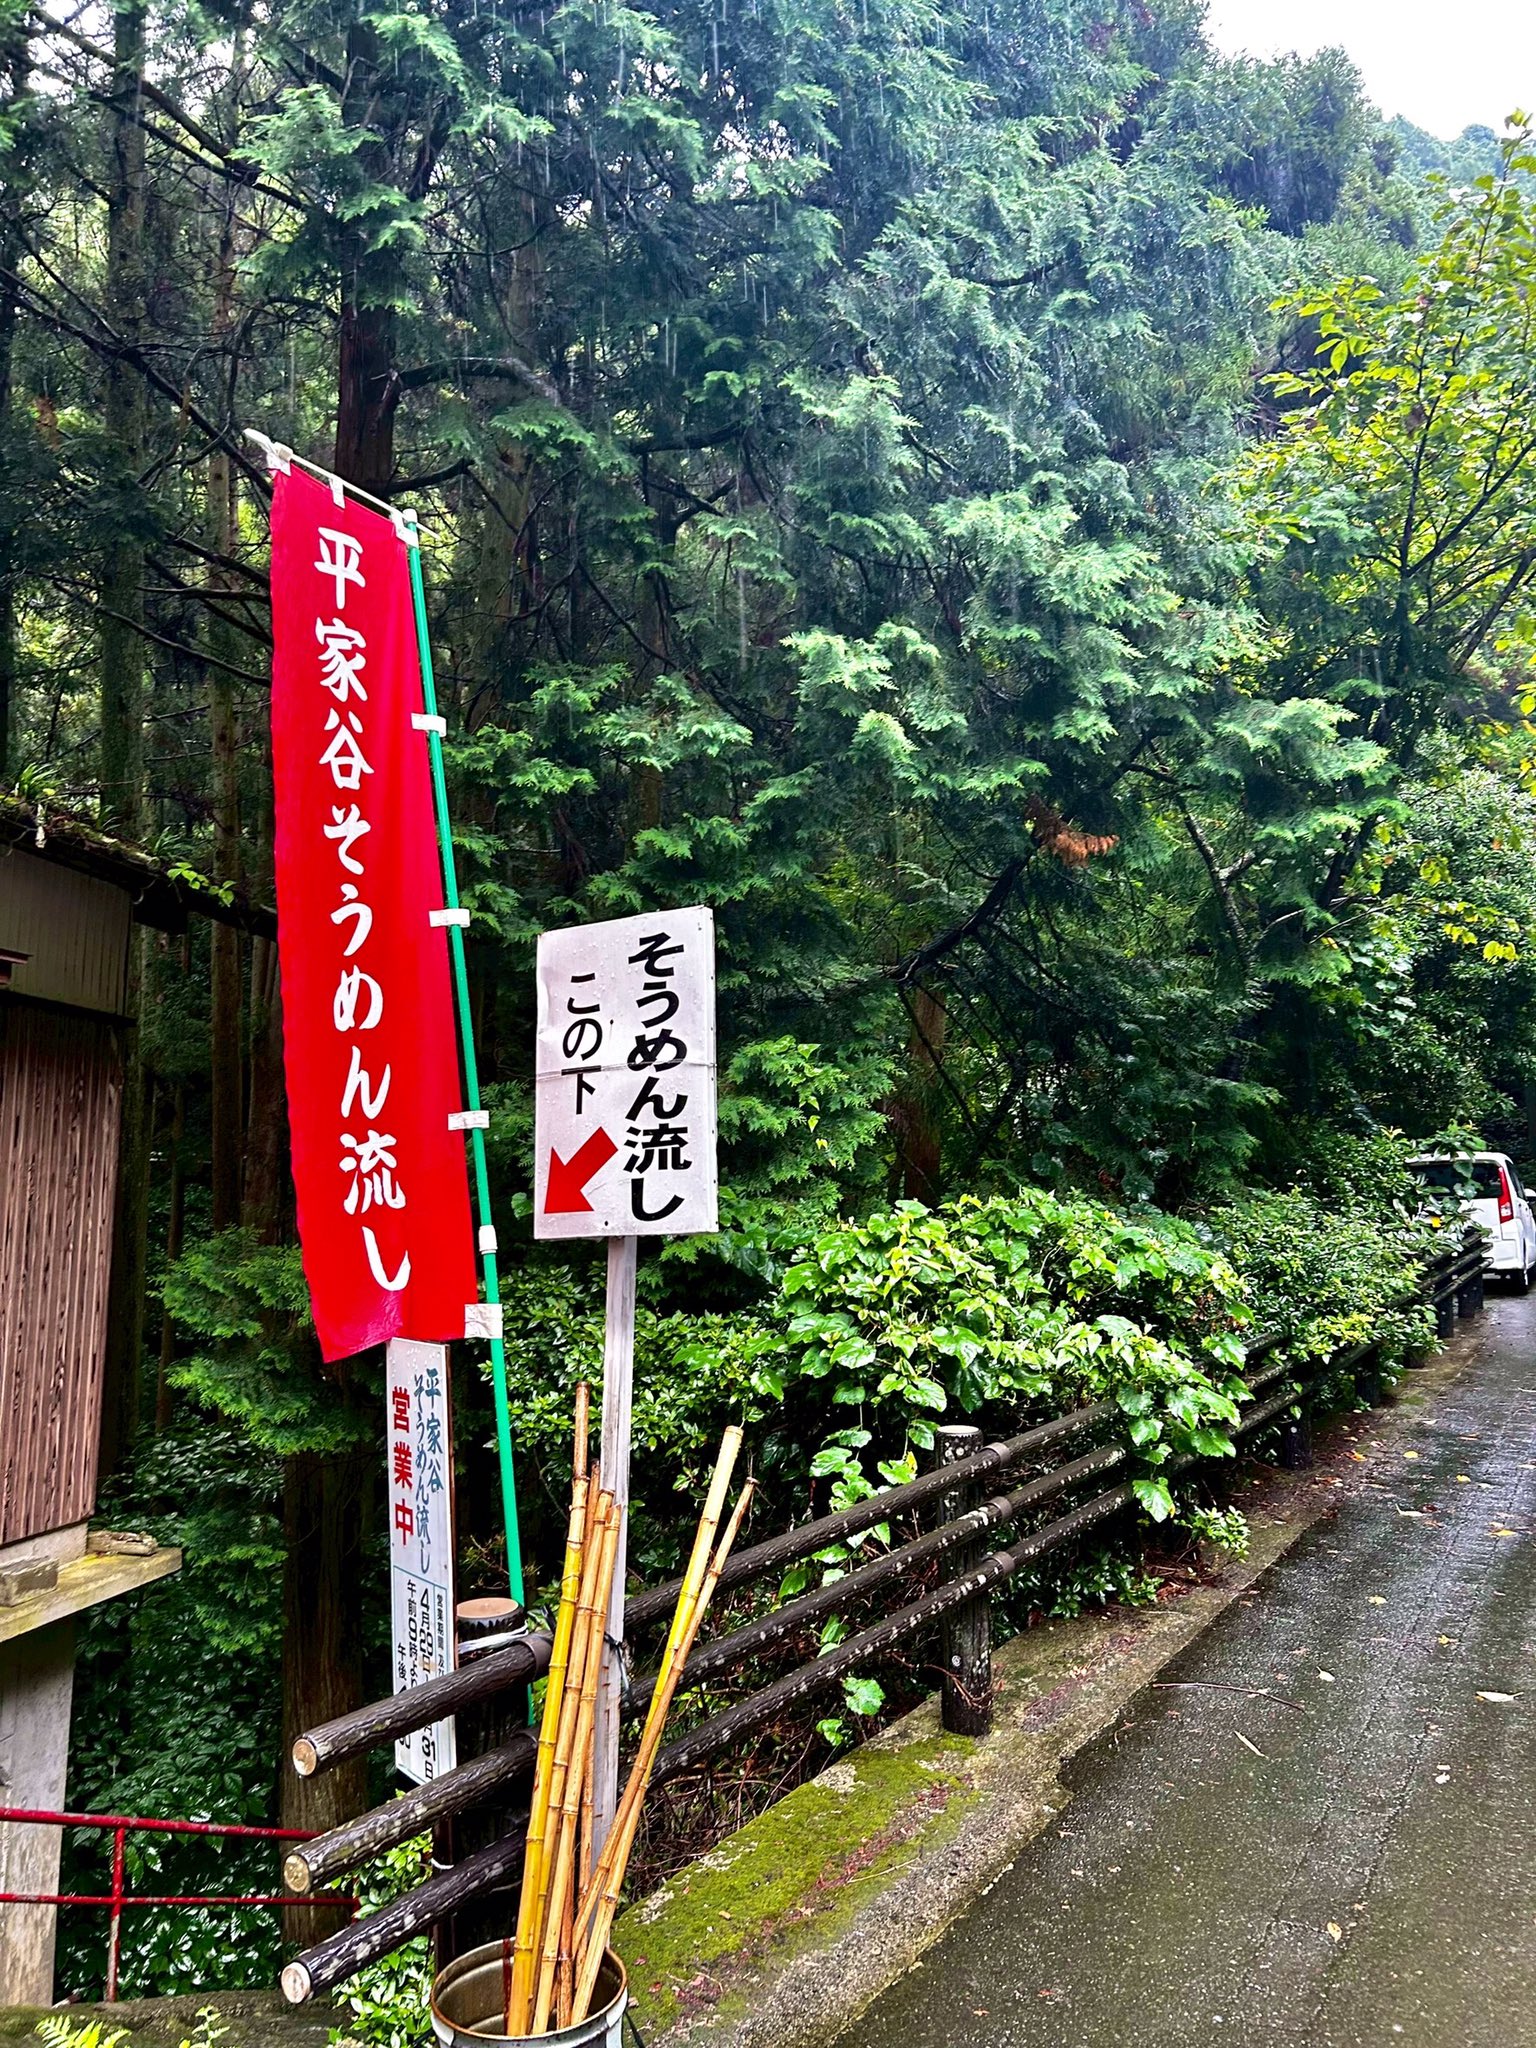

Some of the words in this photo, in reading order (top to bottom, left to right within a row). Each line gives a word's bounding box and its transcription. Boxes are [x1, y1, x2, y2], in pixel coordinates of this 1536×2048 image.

[314, 526, 411, 1292] 平家谷そうめん流し
[561, 973, 603, 1115] この下
[623, 932, 693, 1222] そうめん流し
[392, 1385, 414, 1546] 営業中
[413, 1374, 431, 1575] そうめん流し
[425, 1367, 444, 1493] 平家谷
